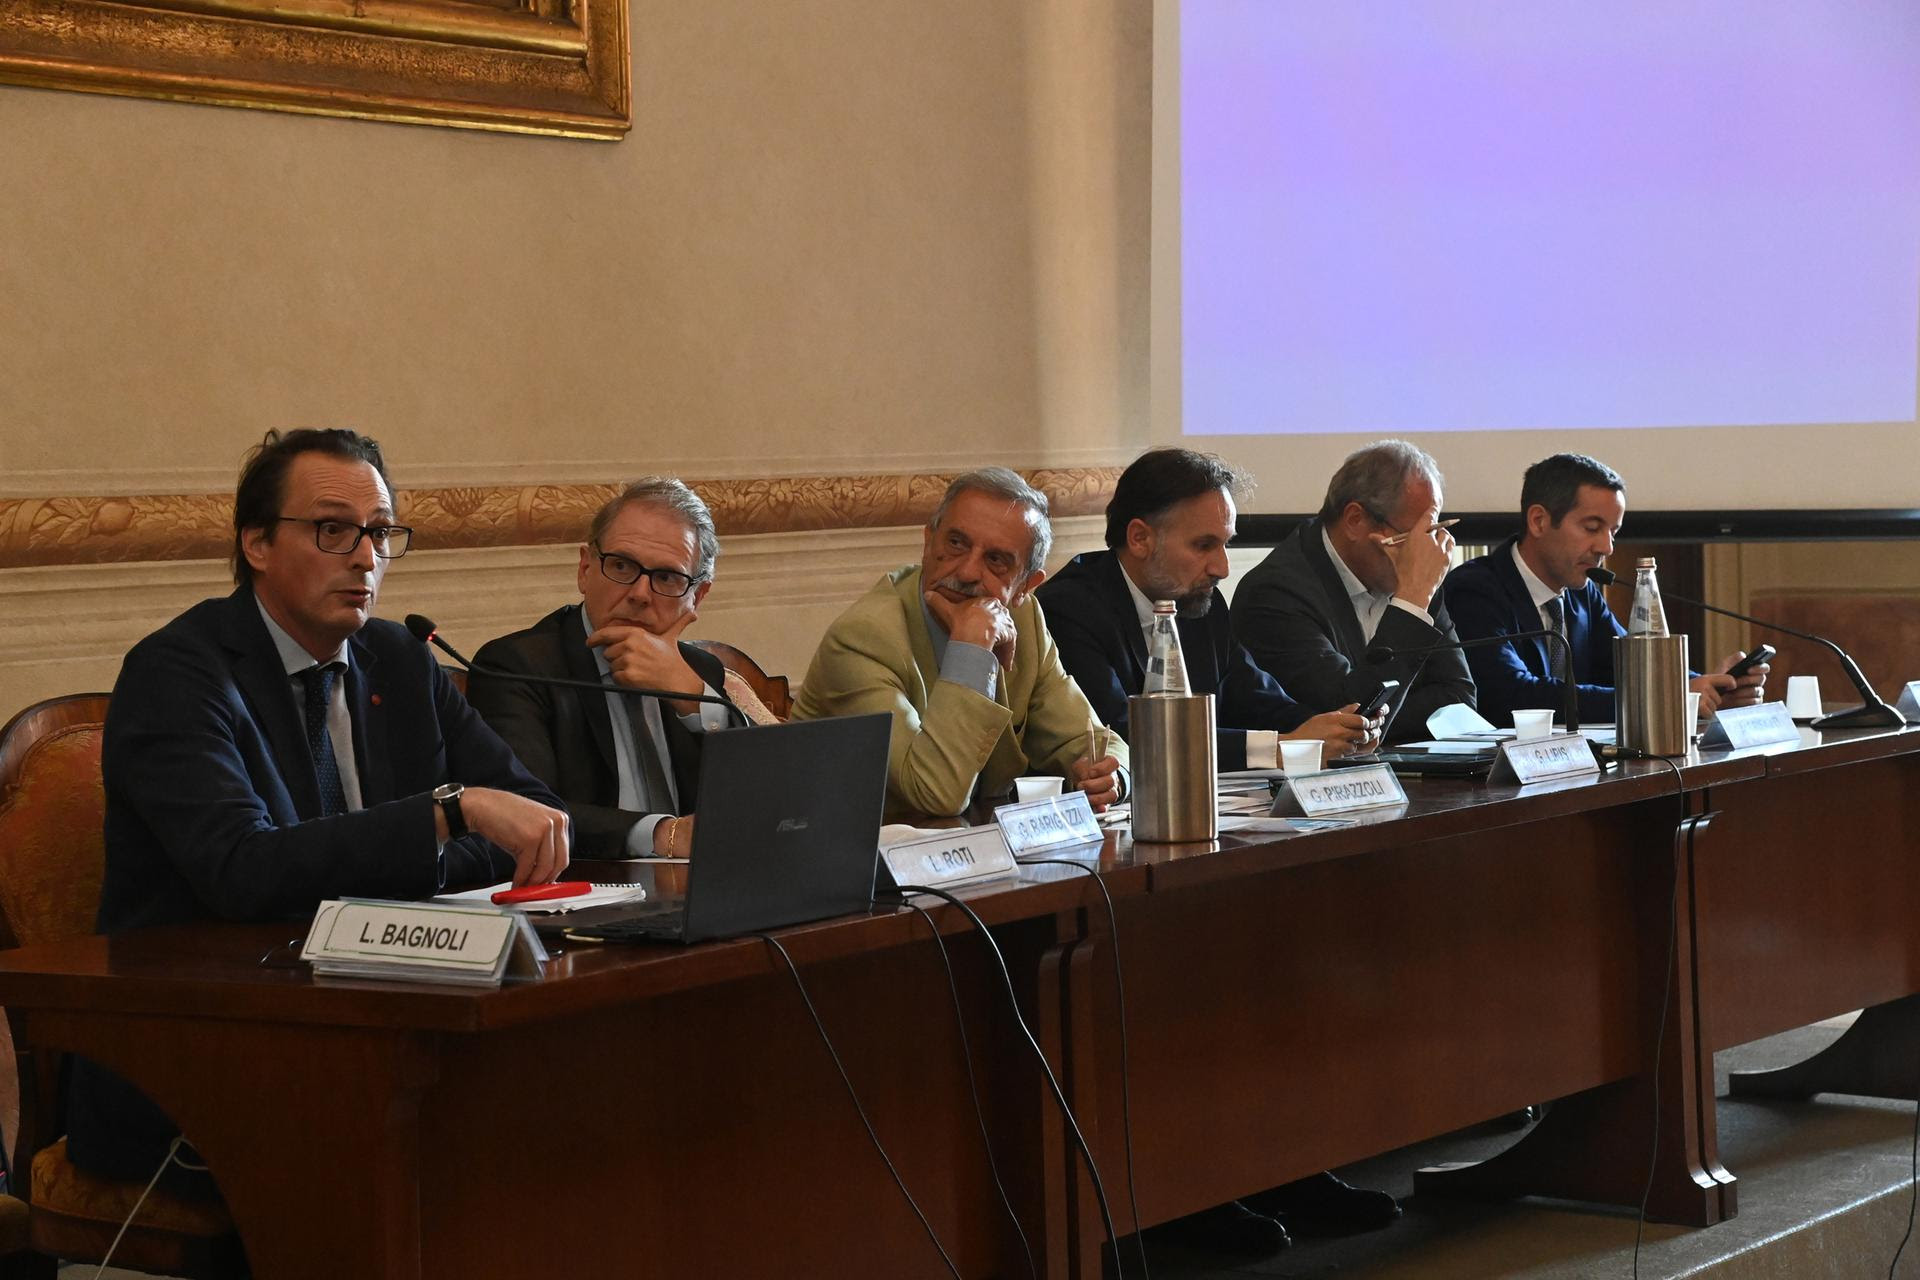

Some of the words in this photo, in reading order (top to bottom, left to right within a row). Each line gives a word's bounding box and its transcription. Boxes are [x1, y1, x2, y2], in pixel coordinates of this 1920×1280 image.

[1324, 779, 1385, 801] PIRAZZOLI
[942, 846, 976, 868] ROTI
[360, 922, 374, 944] L.
[381, 924, 469, 951] BAGNOLI
